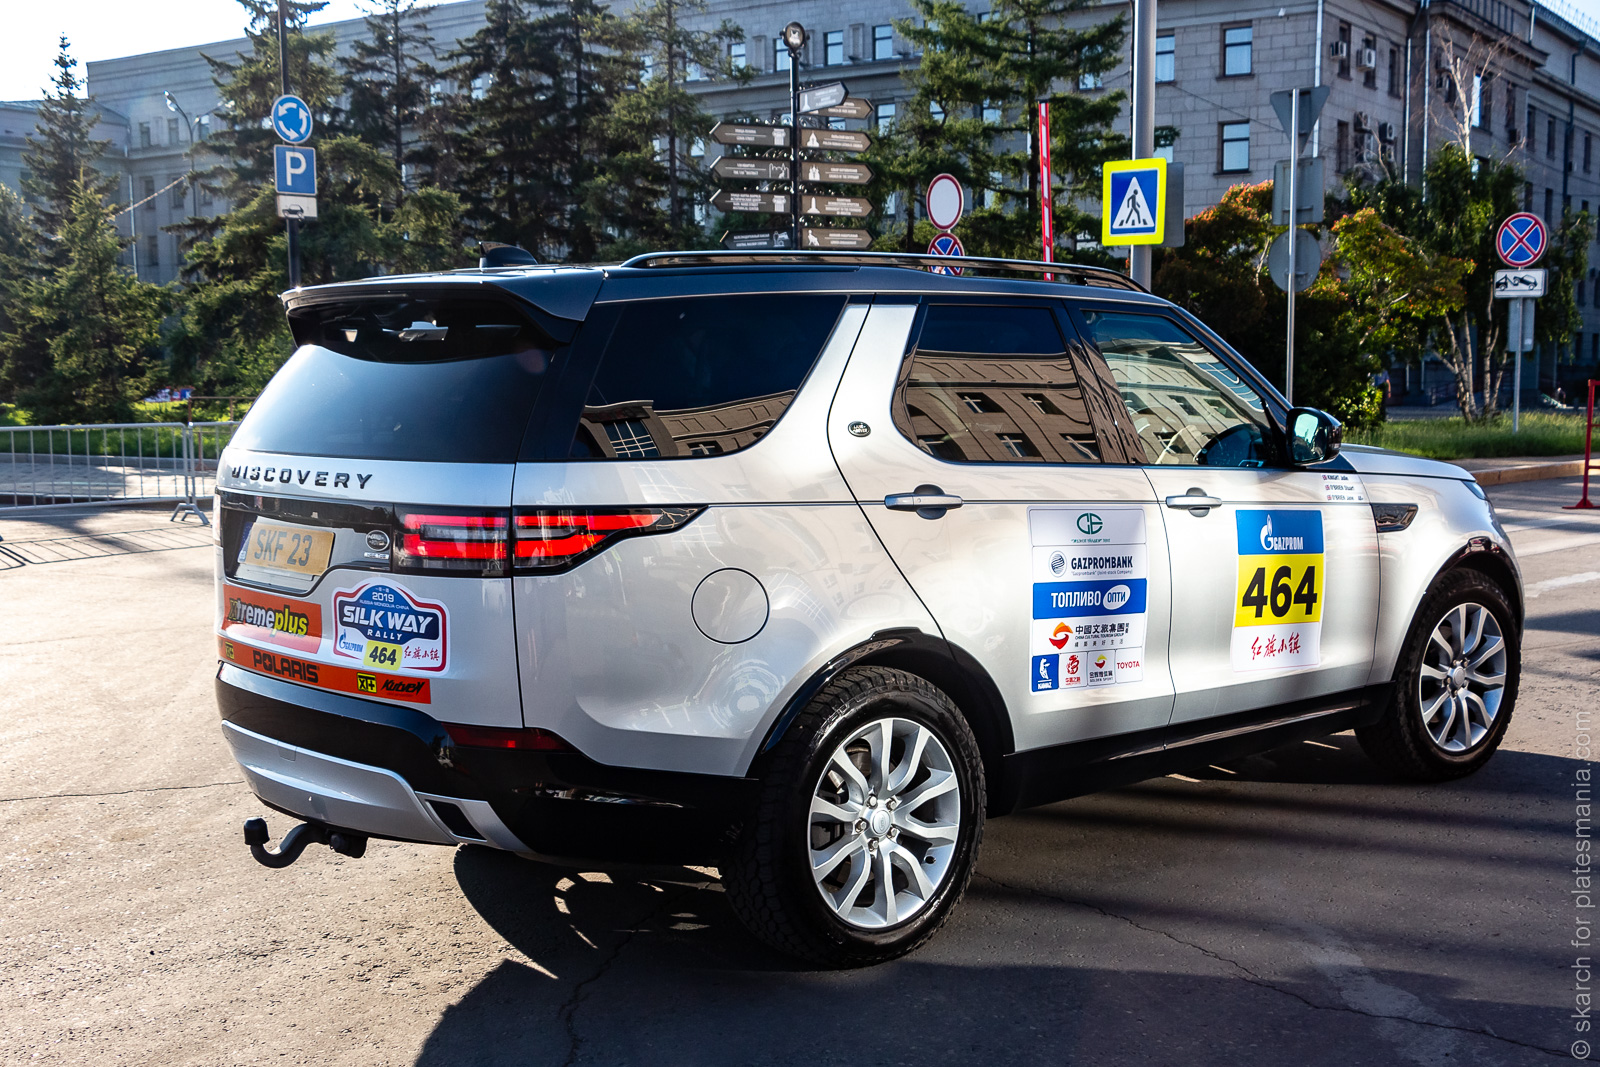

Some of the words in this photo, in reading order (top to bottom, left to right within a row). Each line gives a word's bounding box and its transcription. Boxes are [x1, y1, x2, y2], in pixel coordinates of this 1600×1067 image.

[285, 151, 307, 186] P
[254, 528, 288, 562] SKF
[287, 533, 313, 567] 23
[1071, 555, 1133, 570] GAZPROMBANK
[372, 591, 395, 603] 2019
[1050, 590, 1102, 608] ТОПЛИВО
[1107, 591, 1126, 603] ОПТИ
[1241, 565, 1318, 619] 464
[343, 605, 385, 628] SILK
[387, 611, 433, 634] WAY
[367, 628, 403, 641] RALLY
[369, 645, 397, 666] 464
[1116, 660, 1140, 669] TOYOTA
[253, 650, 319, 684] POLARIS
